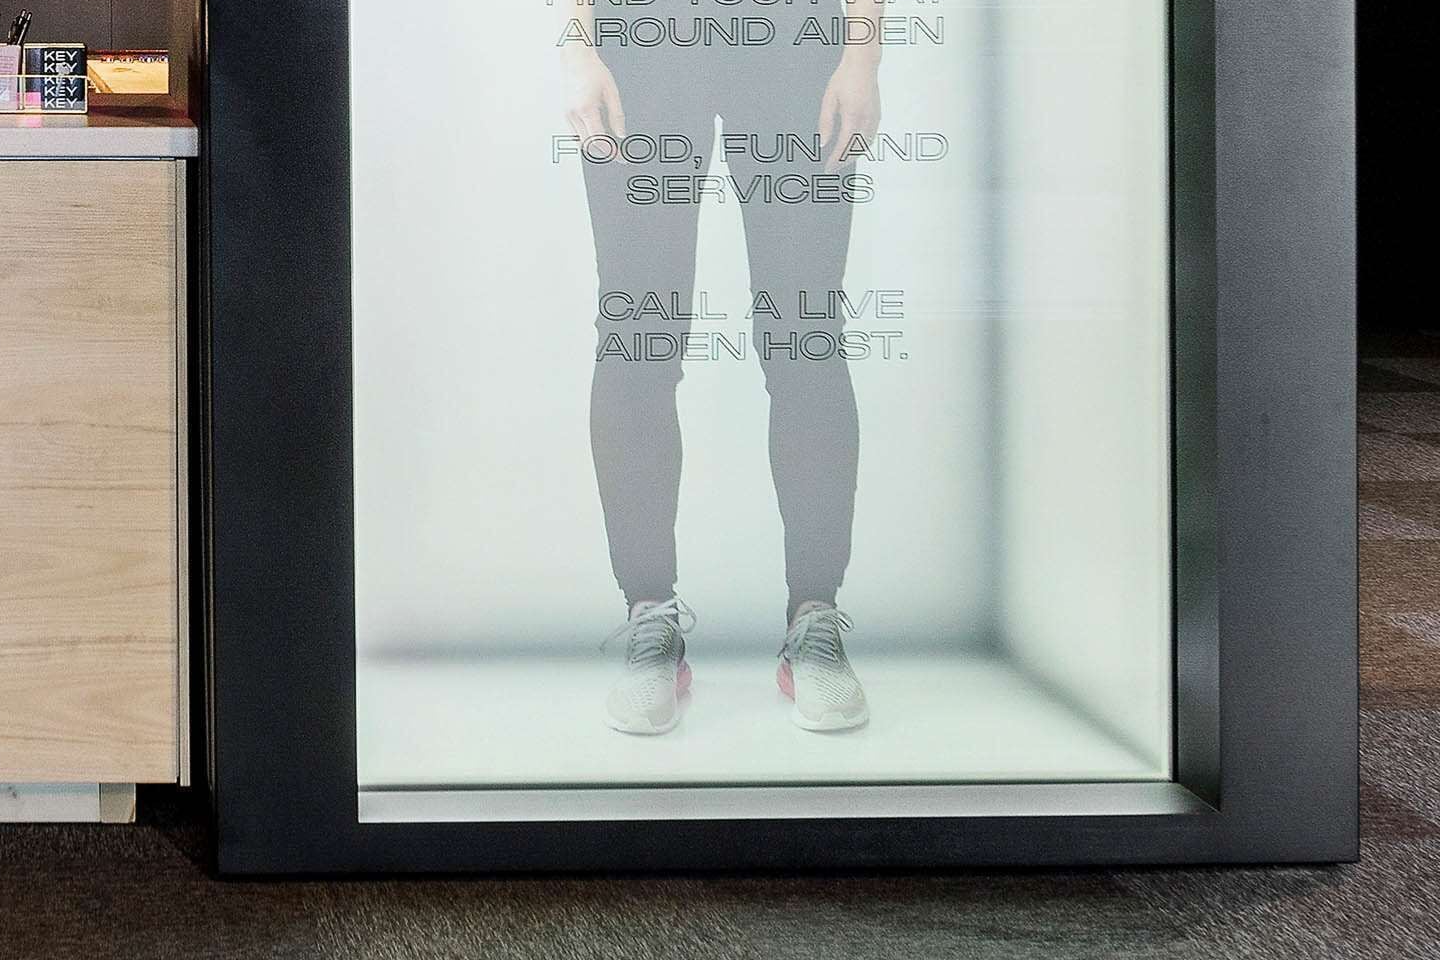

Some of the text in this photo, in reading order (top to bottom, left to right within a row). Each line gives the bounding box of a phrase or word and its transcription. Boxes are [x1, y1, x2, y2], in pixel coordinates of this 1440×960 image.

[556, 16, 945, 47] AROUND AIDEN
[44, 50, 78, 62] KEY
[44, 98, 78, 109] KEY
[551, 133, 948, 169] FOOD, FUN AND
[626, 173, 875, 205] SERVICES
[598, 290, 905, 321] CALL A LIVE
[596, 331, 909, 362] AIDEN HOST.
